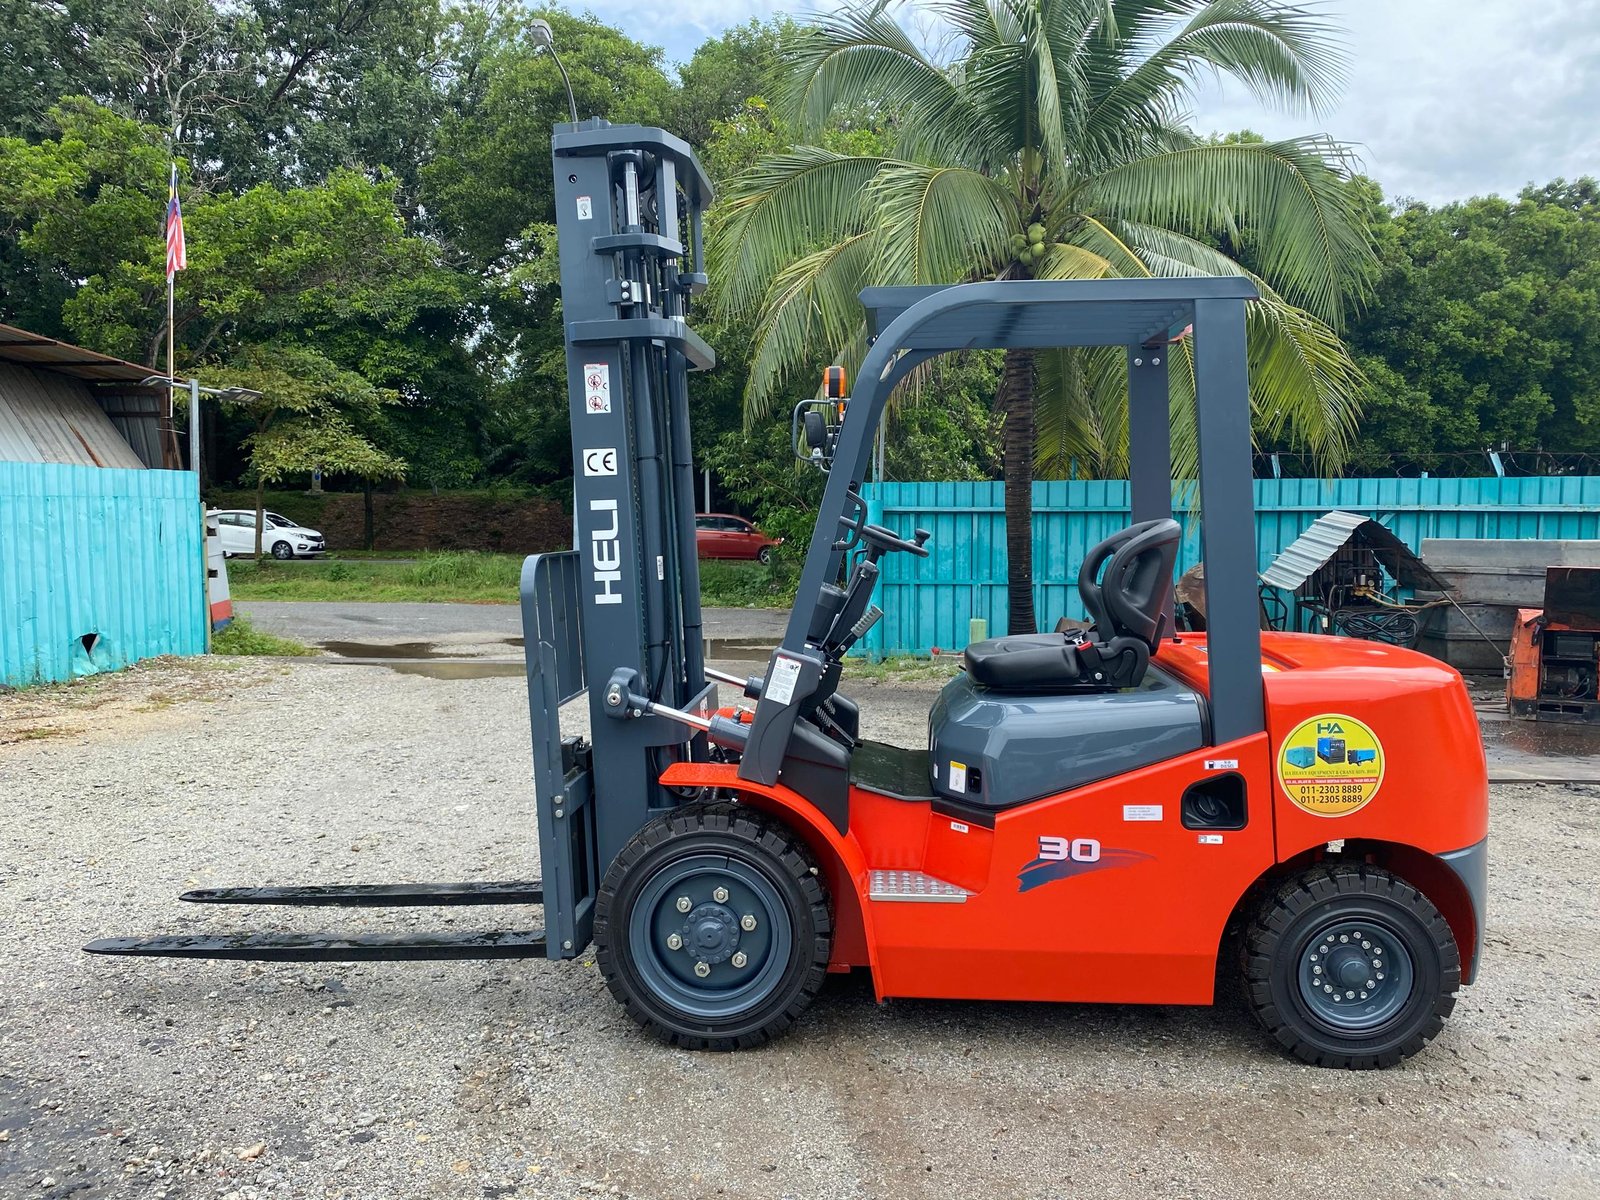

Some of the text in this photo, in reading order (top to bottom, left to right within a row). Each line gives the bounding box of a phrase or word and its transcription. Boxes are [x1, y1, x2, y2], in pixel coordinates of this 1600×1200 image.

[590, 499, 622, 604] HELI
[1317, 722, 1345, 734] HA
[1300, 784, 1363, 794] 011-2303 8889
[1300, 794, 1363, 804] 011-2305 8889
[1038, 836, 1101, 862] 30
